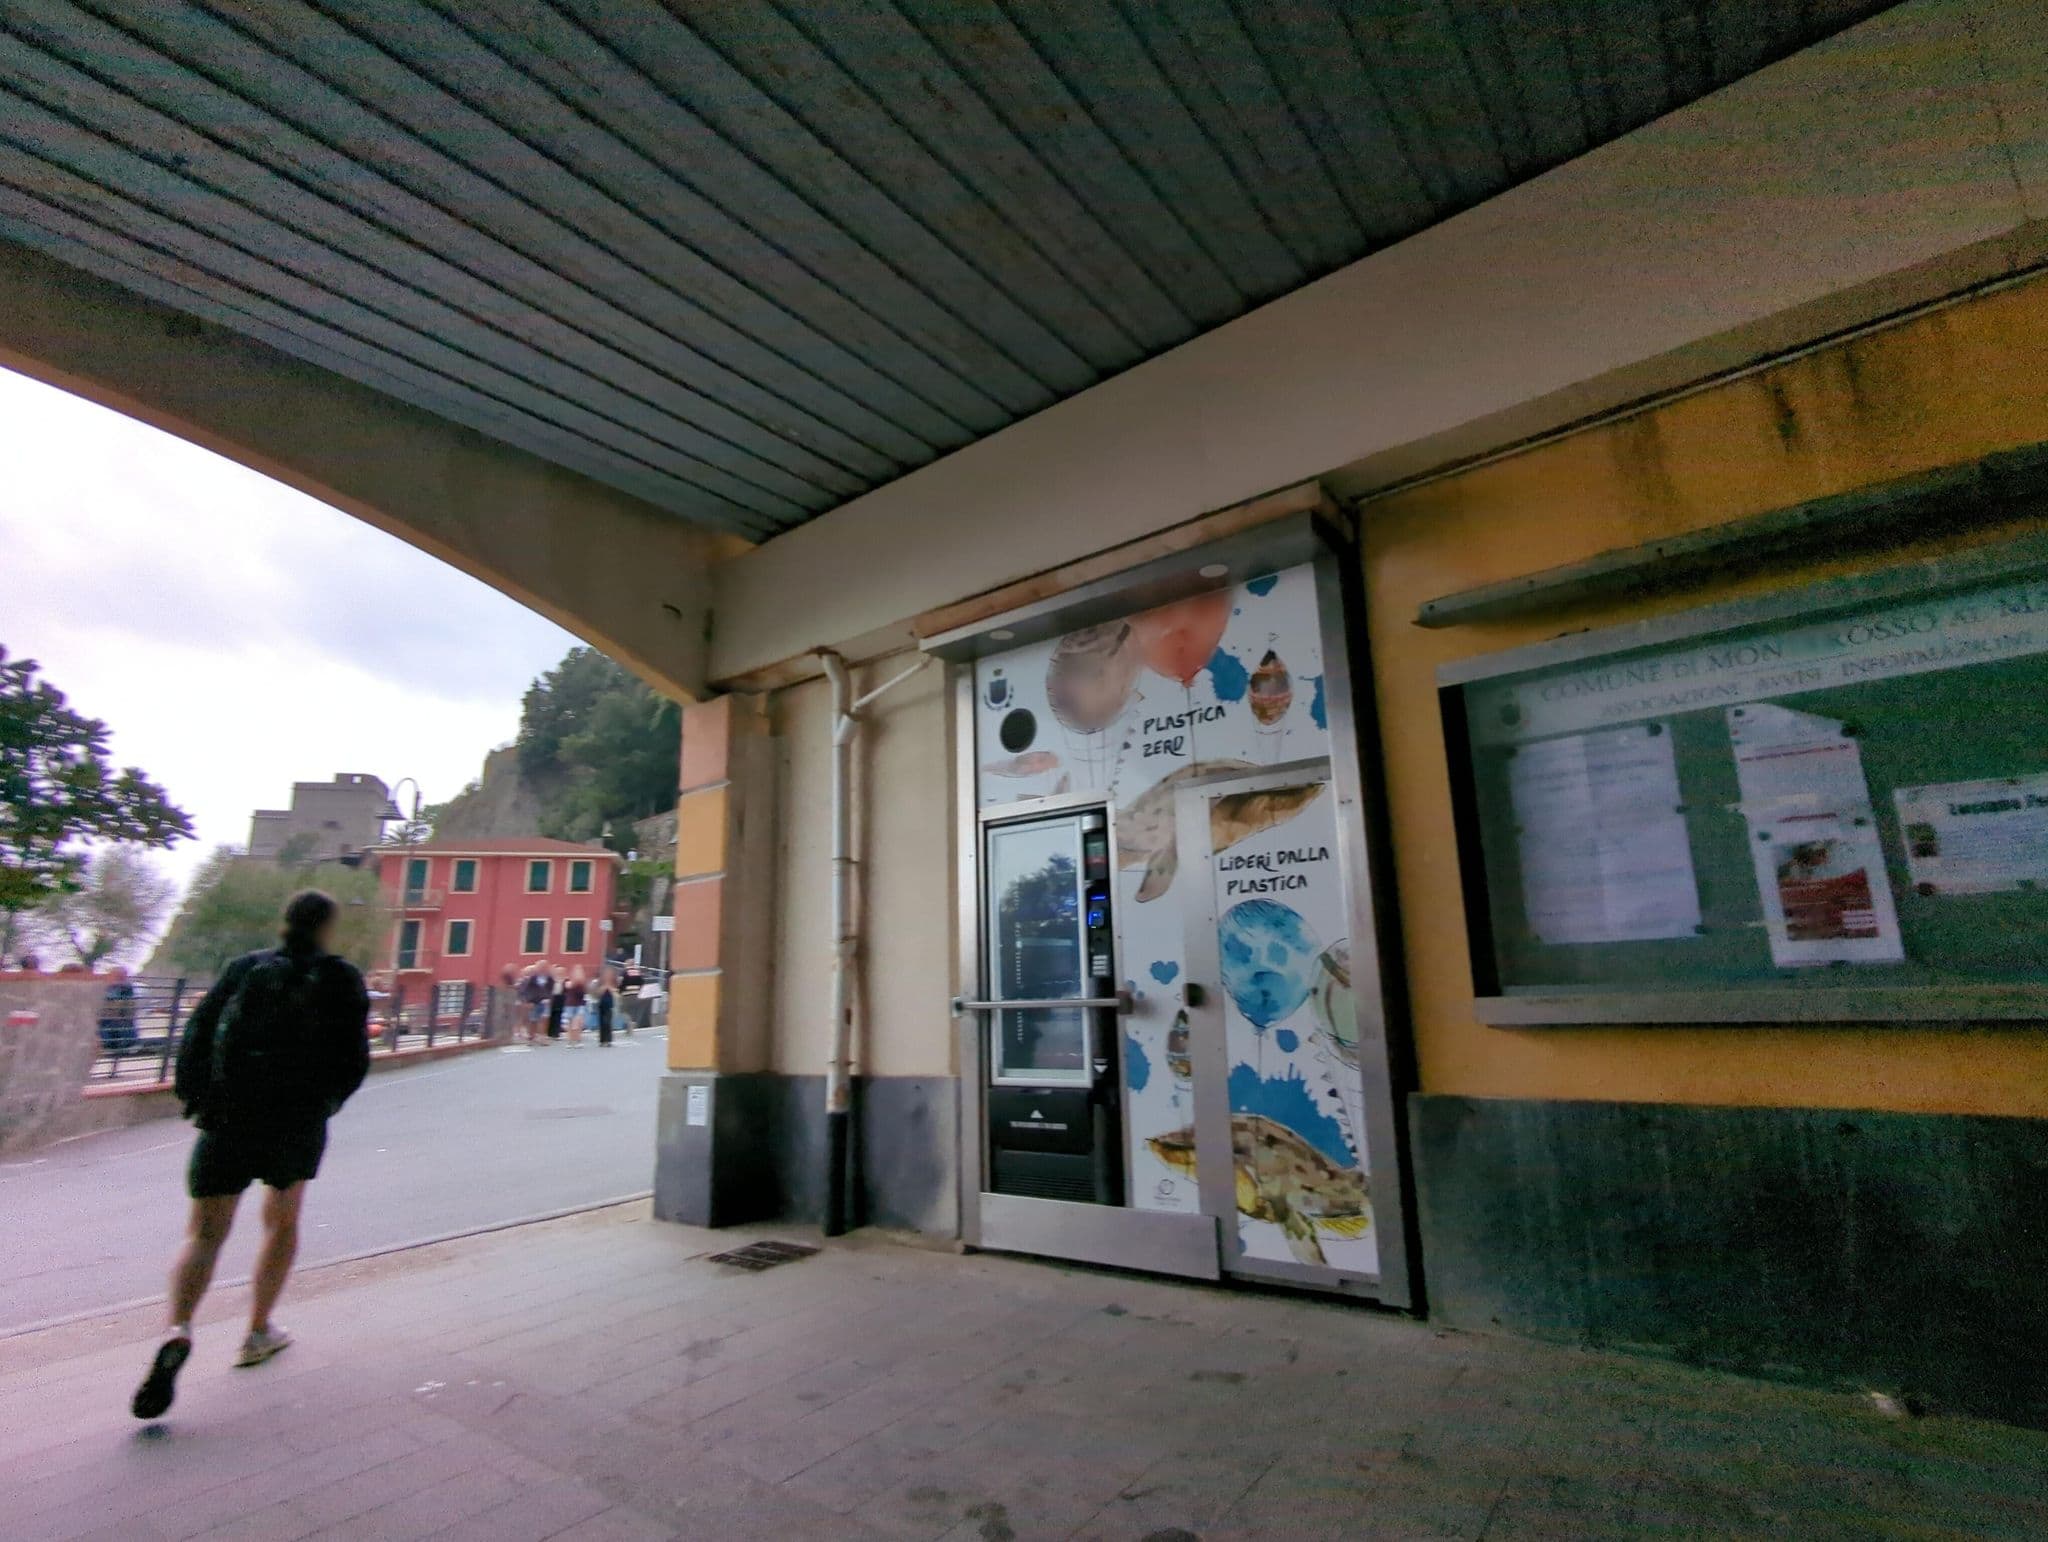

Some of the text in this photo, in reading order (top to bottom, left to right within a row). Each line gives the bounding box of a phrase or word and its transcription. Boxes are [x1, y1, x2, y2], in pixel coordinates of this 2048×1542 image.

[1541, 662, 1661, 702] COMUNE
[1143, 735, 1186, 758] ZERO
[1277, 846, 1329, 865] DALLA
